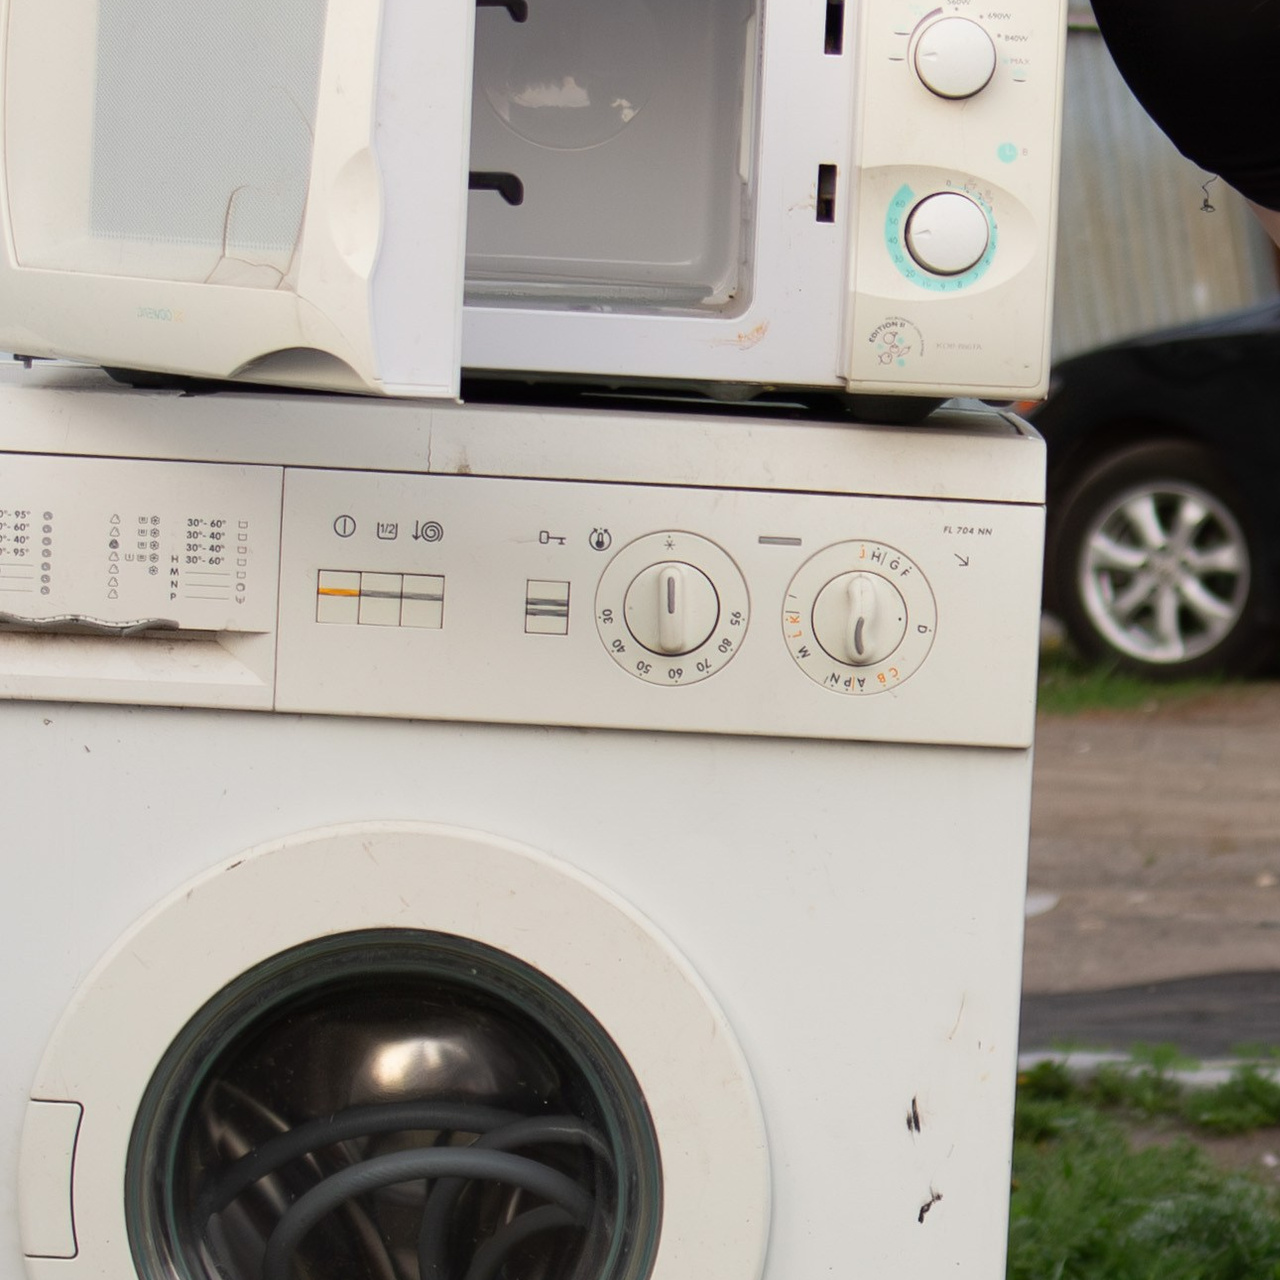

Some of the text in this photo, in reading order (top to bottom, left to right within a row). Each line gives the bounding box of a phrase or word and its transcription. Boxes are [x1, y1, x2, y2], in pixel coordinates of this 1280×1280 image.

[868, 321, 898, 343] EDITION
[381, 523, 395, 535] 1/2
[943, 525, 993, 536] FL 704 NN
[171, 555, 179, 563] H
[859, 549, 866, 559] J
[871, 551, 882, 562] H
[890, 560, 900, 570] G
[170, 567, 179, 576] M
[900, 569, 910, 577] F
[170, 580, 178, 588] N
[170, 593, 176, 601] P
[602, 609, 614, 624] 30
[730, 611, 742, 626] 95
[790, 615, 800, 624] K
[792, 630, 802, 638] L
[917, 624, 928, 634] D
[612, 639, 626, 653] 40
[718, 638, 732, 653] 80
[798, 645, 811, 659] M
[636, 660, 652, 675] 50
[696, 658, 712, 672] 70
[668, 668, 684, 679] 60
[830, 672, 841, 684] N
[877, 673, 886, 683] B
[888, 667, 899, 678] C
[844, 677, 852, 687] P
[857, 677, 866, 687] A
